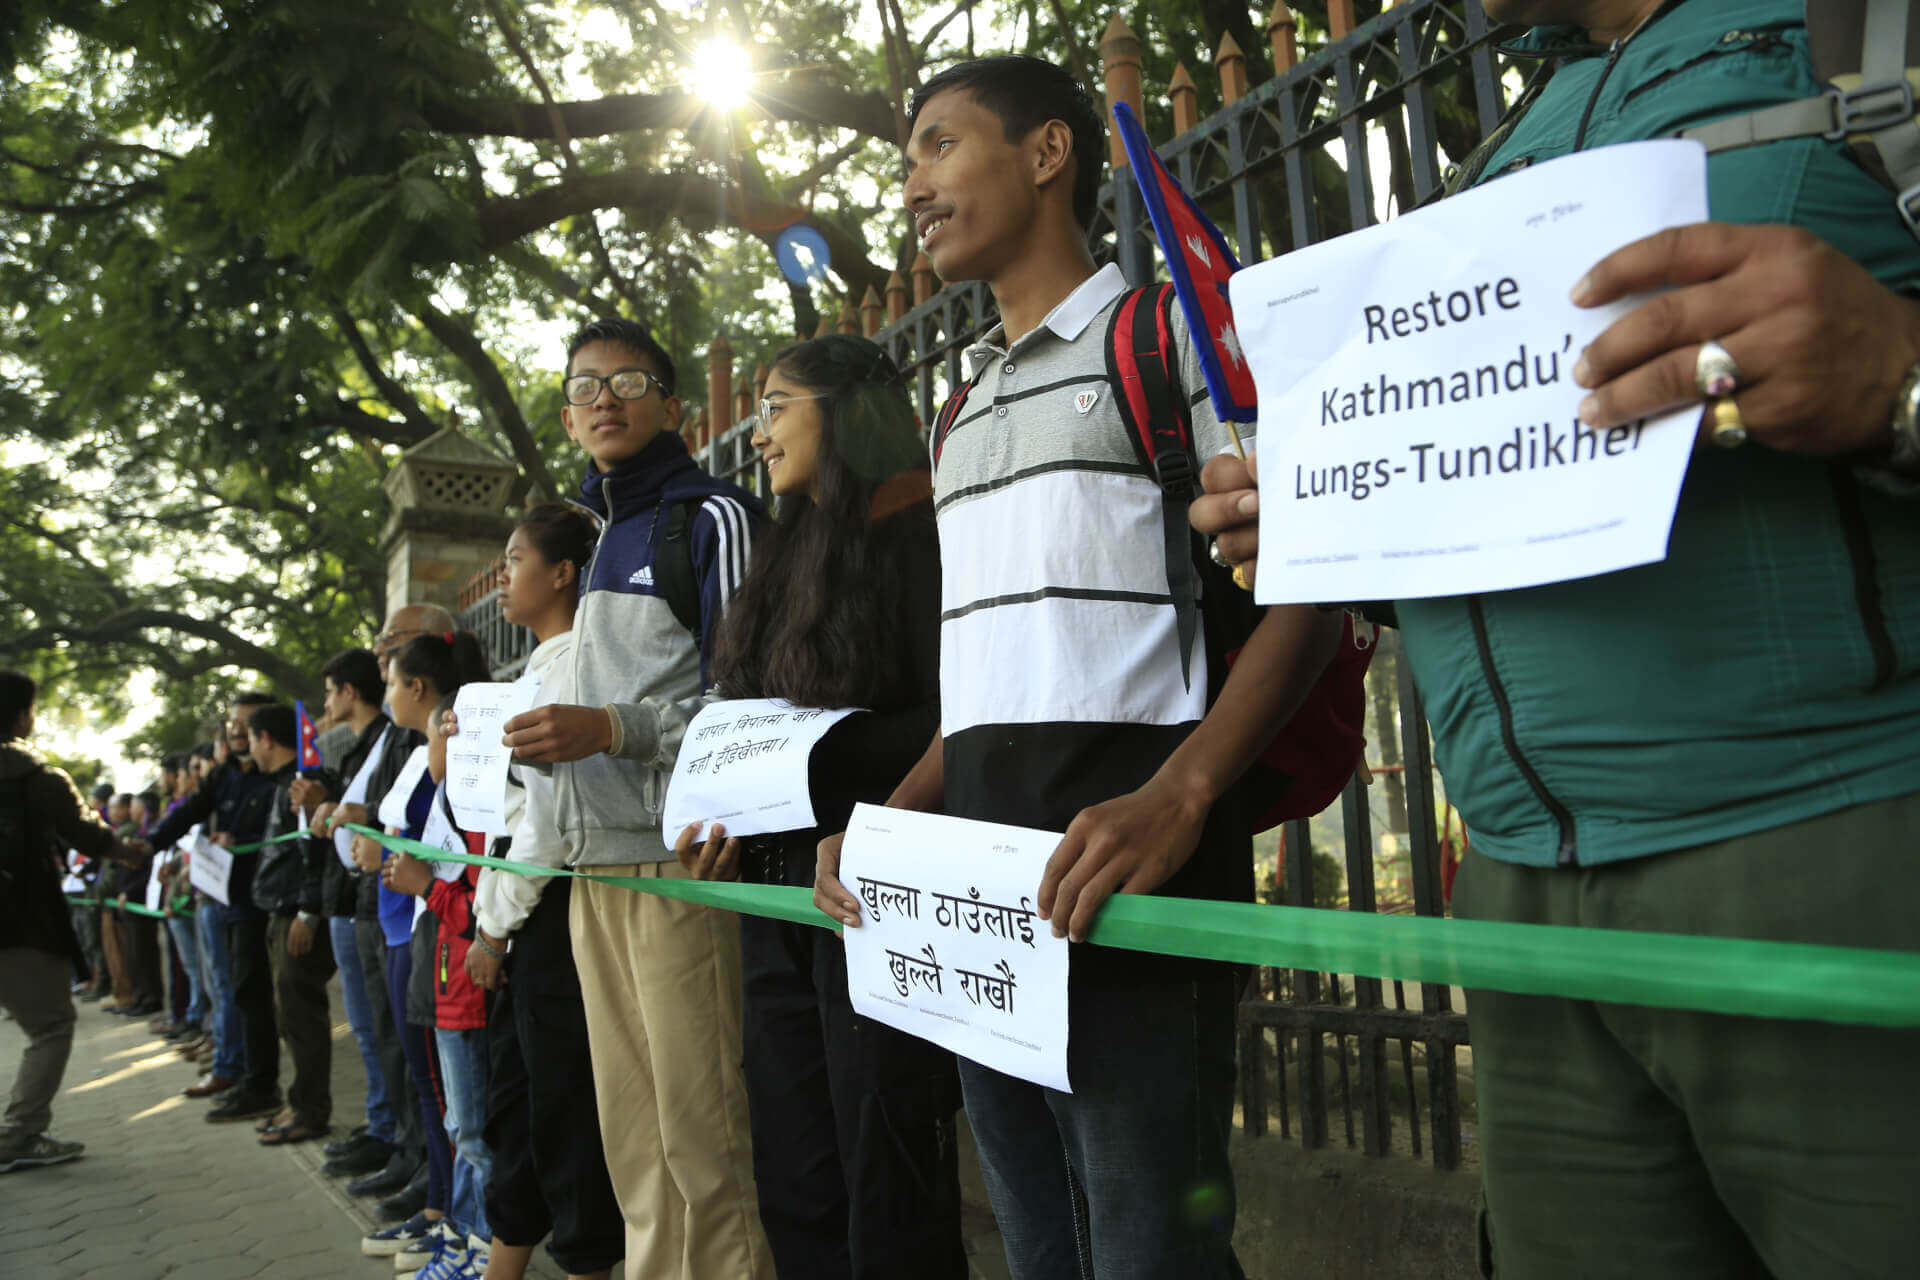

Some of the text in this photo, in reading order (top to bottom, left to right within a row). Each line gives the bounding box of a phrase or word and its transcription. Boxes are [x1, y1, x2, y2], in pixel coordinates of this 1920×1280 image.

[1364, 276, 1522, 344] Restore
[1321, 334, 1573, 427] Kathmandu'
[857, 877, 1038, 949] खुल्ला ठाउँलाई
[886, 944, 1018, 1017] खुल्लै राखौं
